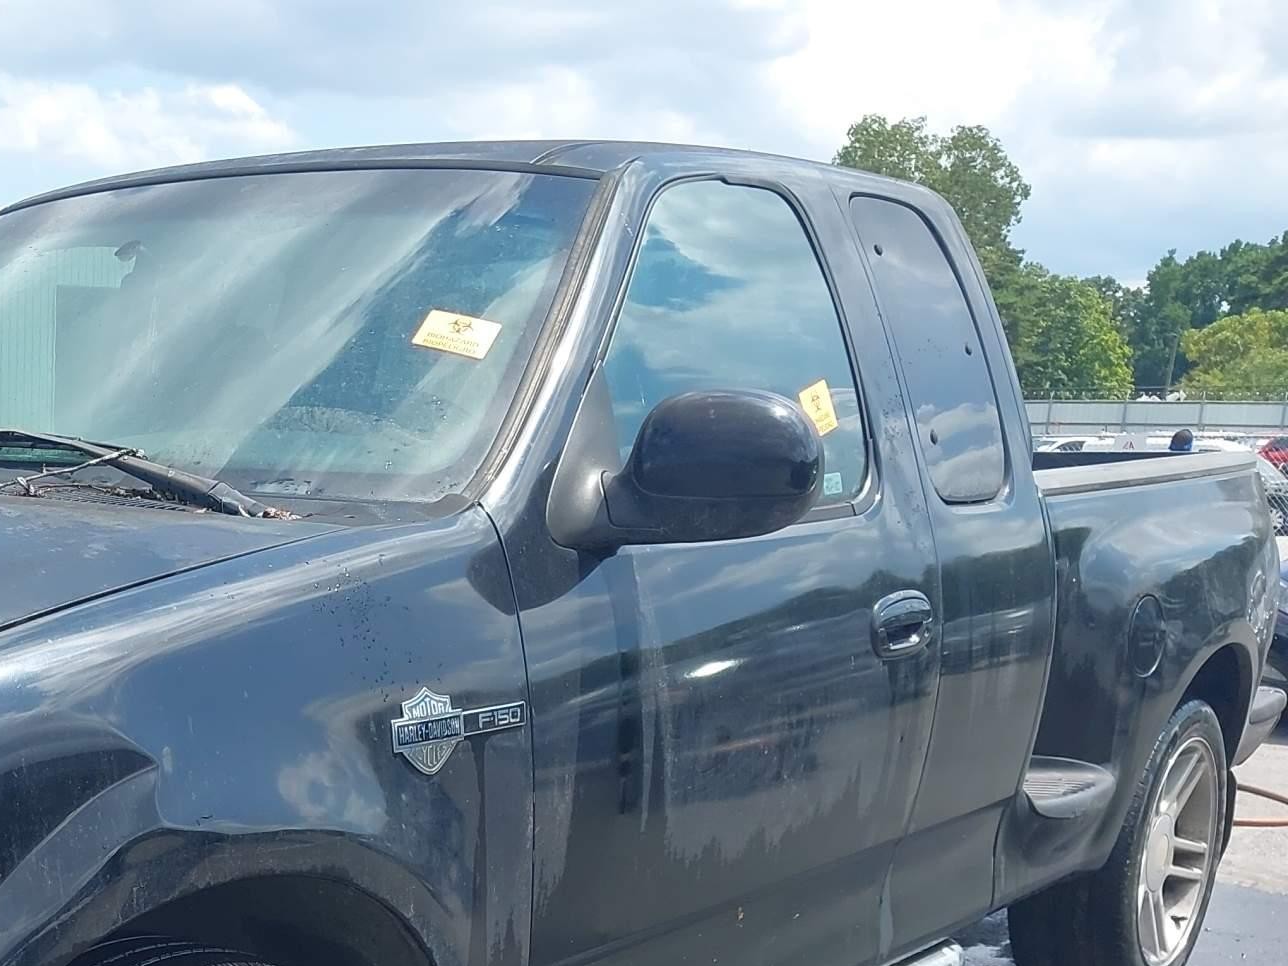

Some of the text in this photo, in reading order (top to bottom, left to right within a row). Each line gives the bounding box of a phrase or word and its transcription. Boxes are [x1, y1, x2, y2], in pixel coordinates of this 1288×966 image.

[411, 697, 445, 719] MOTOR
[478, 707, 521, 729] F-150
[398, 716, 460, 745] HARLEY-DAVIDSON
